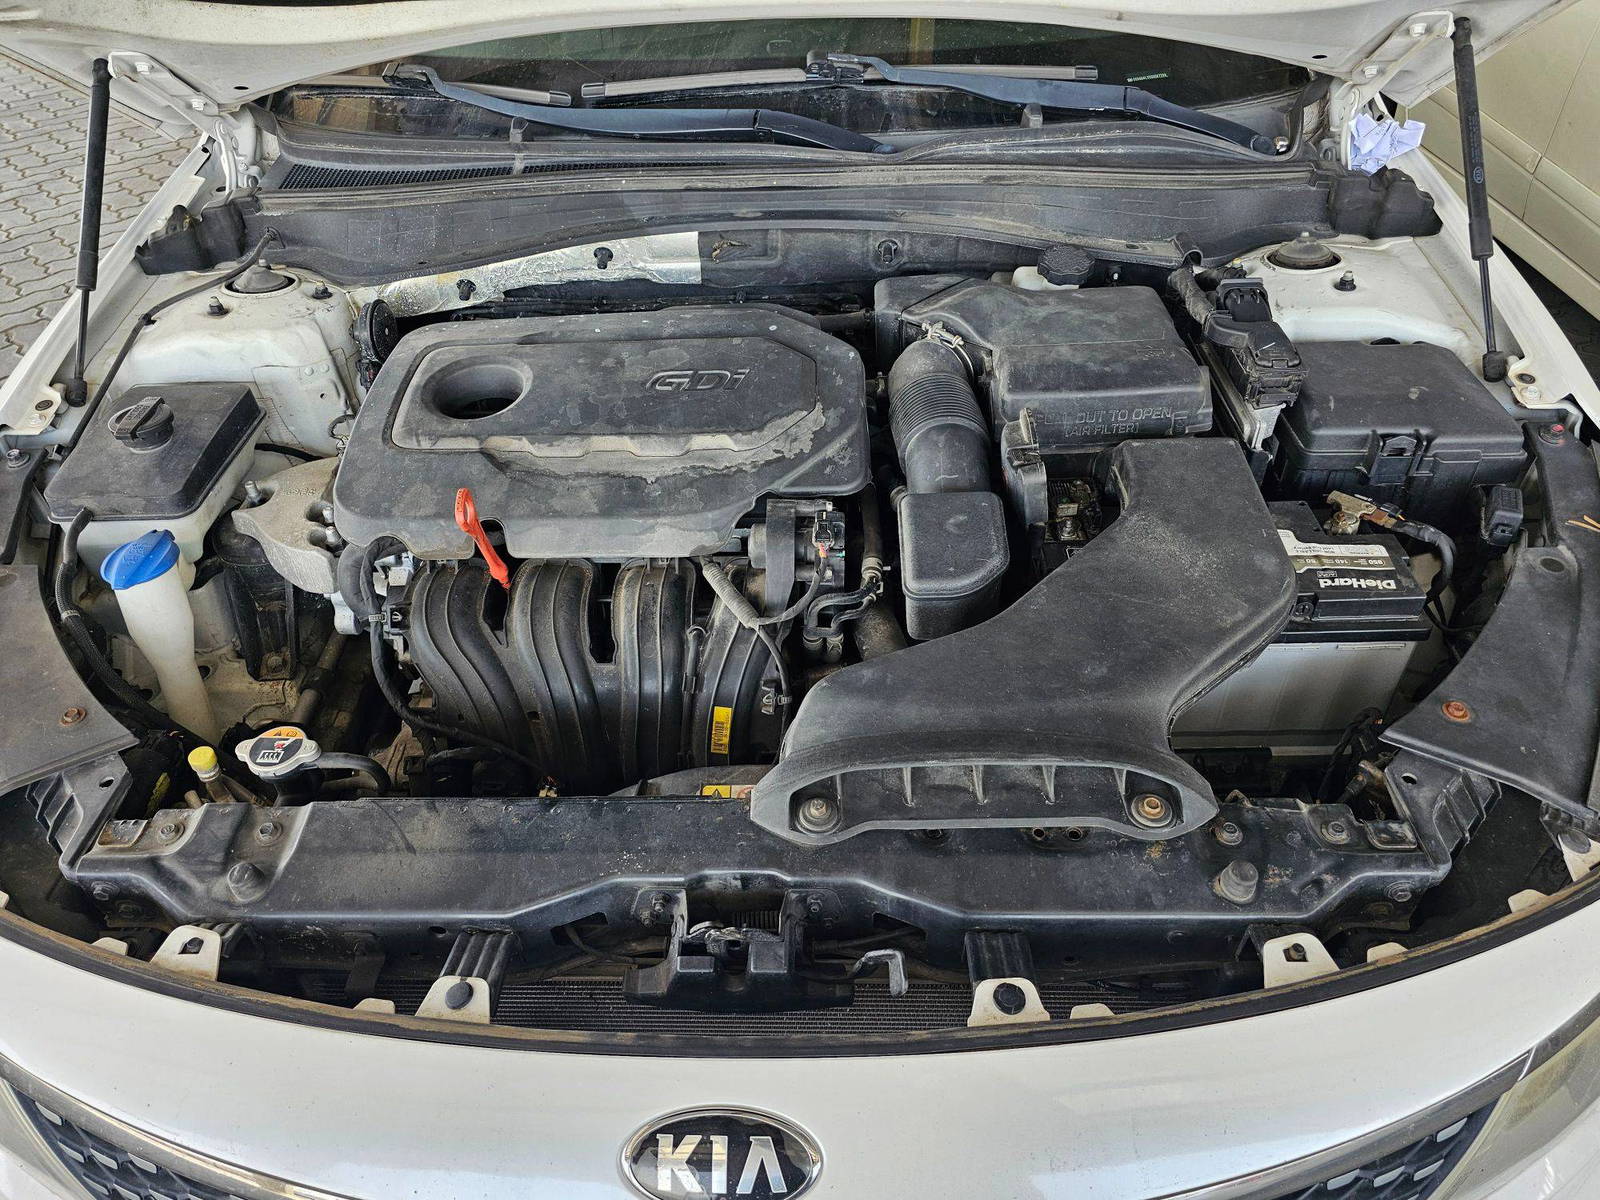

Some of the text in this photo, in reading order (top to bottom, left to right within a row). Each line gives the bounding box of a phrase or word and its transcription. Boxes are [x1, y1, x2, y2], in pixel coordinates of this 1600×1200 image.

[646, 368, 750, 391] GDi
[1077, 410, 1104, 424] OUT
[1110, 408, 1129, 421] TO
[1131, 406, 1172, 420] OPEN
[1319, 577, 1397, 590] DieHard
[656, 1133, 787, 1194] KIA
